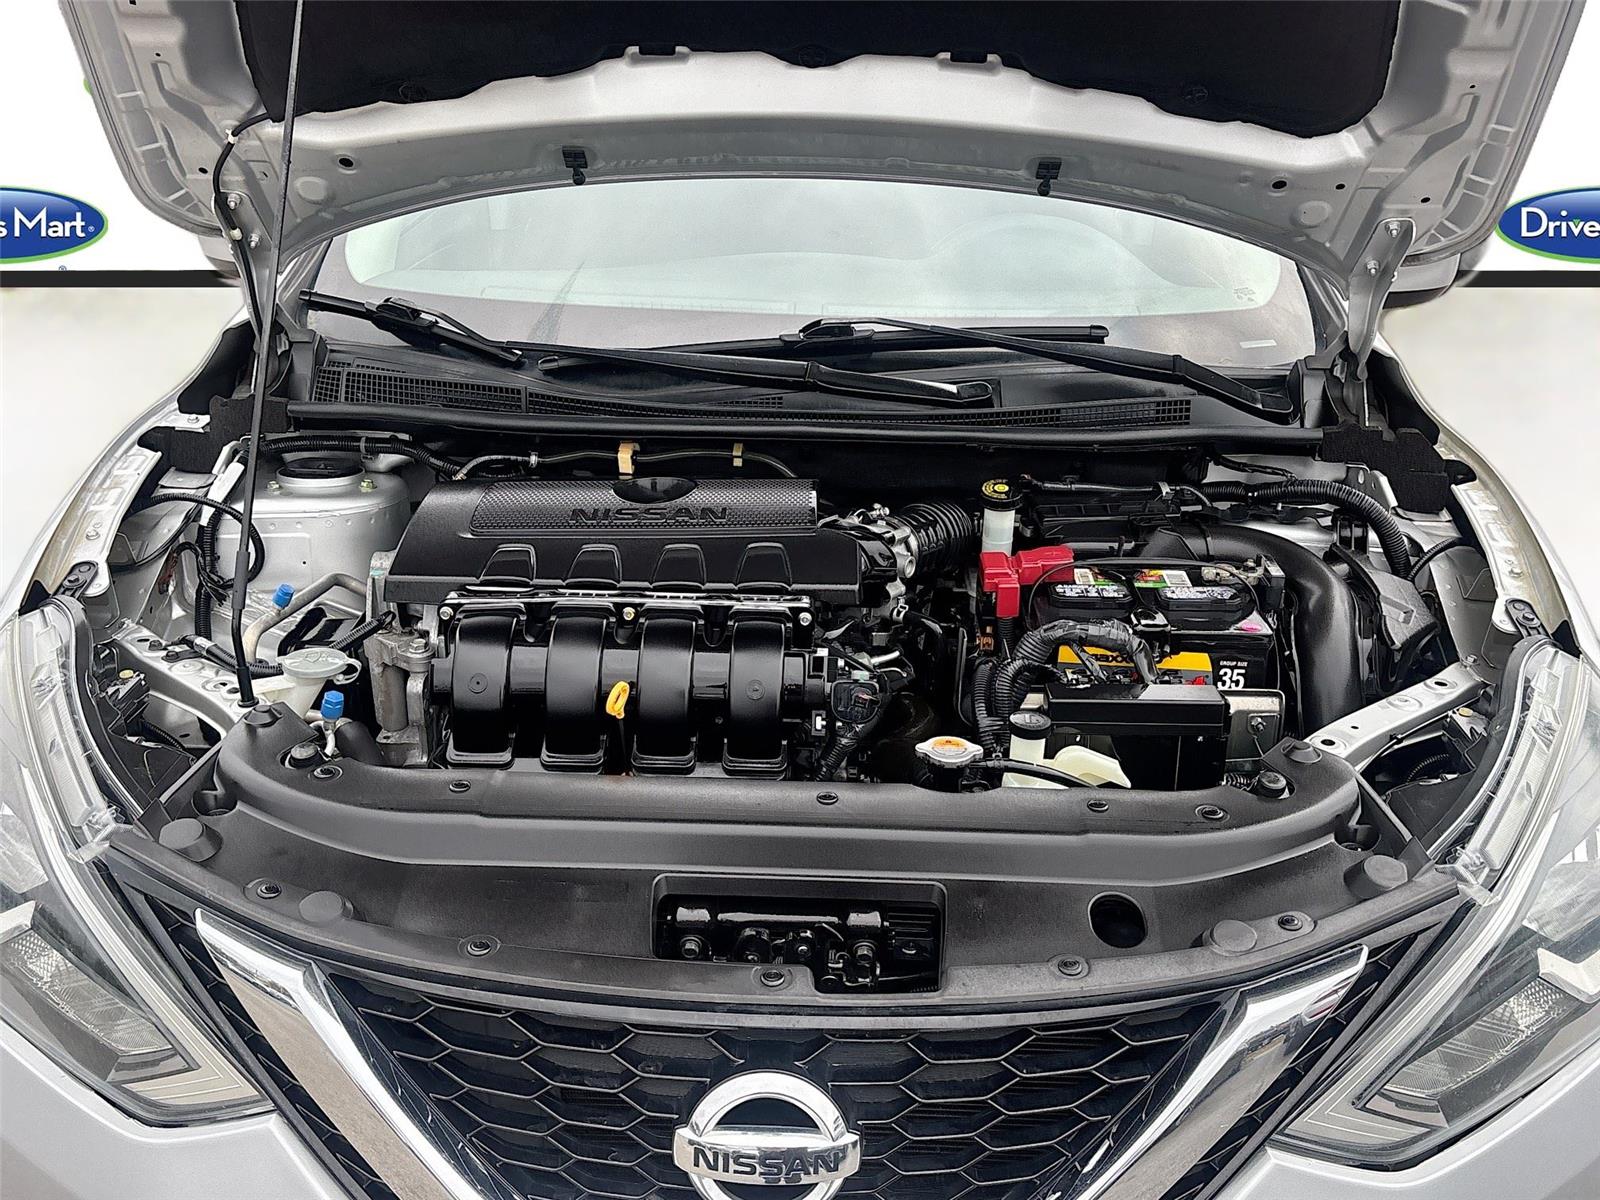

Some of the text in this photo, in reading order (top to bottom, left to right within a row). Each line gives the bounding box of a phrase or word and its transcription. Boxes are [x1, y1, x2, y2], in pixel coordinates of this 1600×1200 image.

[14, 206, 86, 238] Mart
[569, 507, 728, 523] NISSAN
[1217, 667, 1245, 690] 35
[693, 1146, 840, 1178] NISSAN
